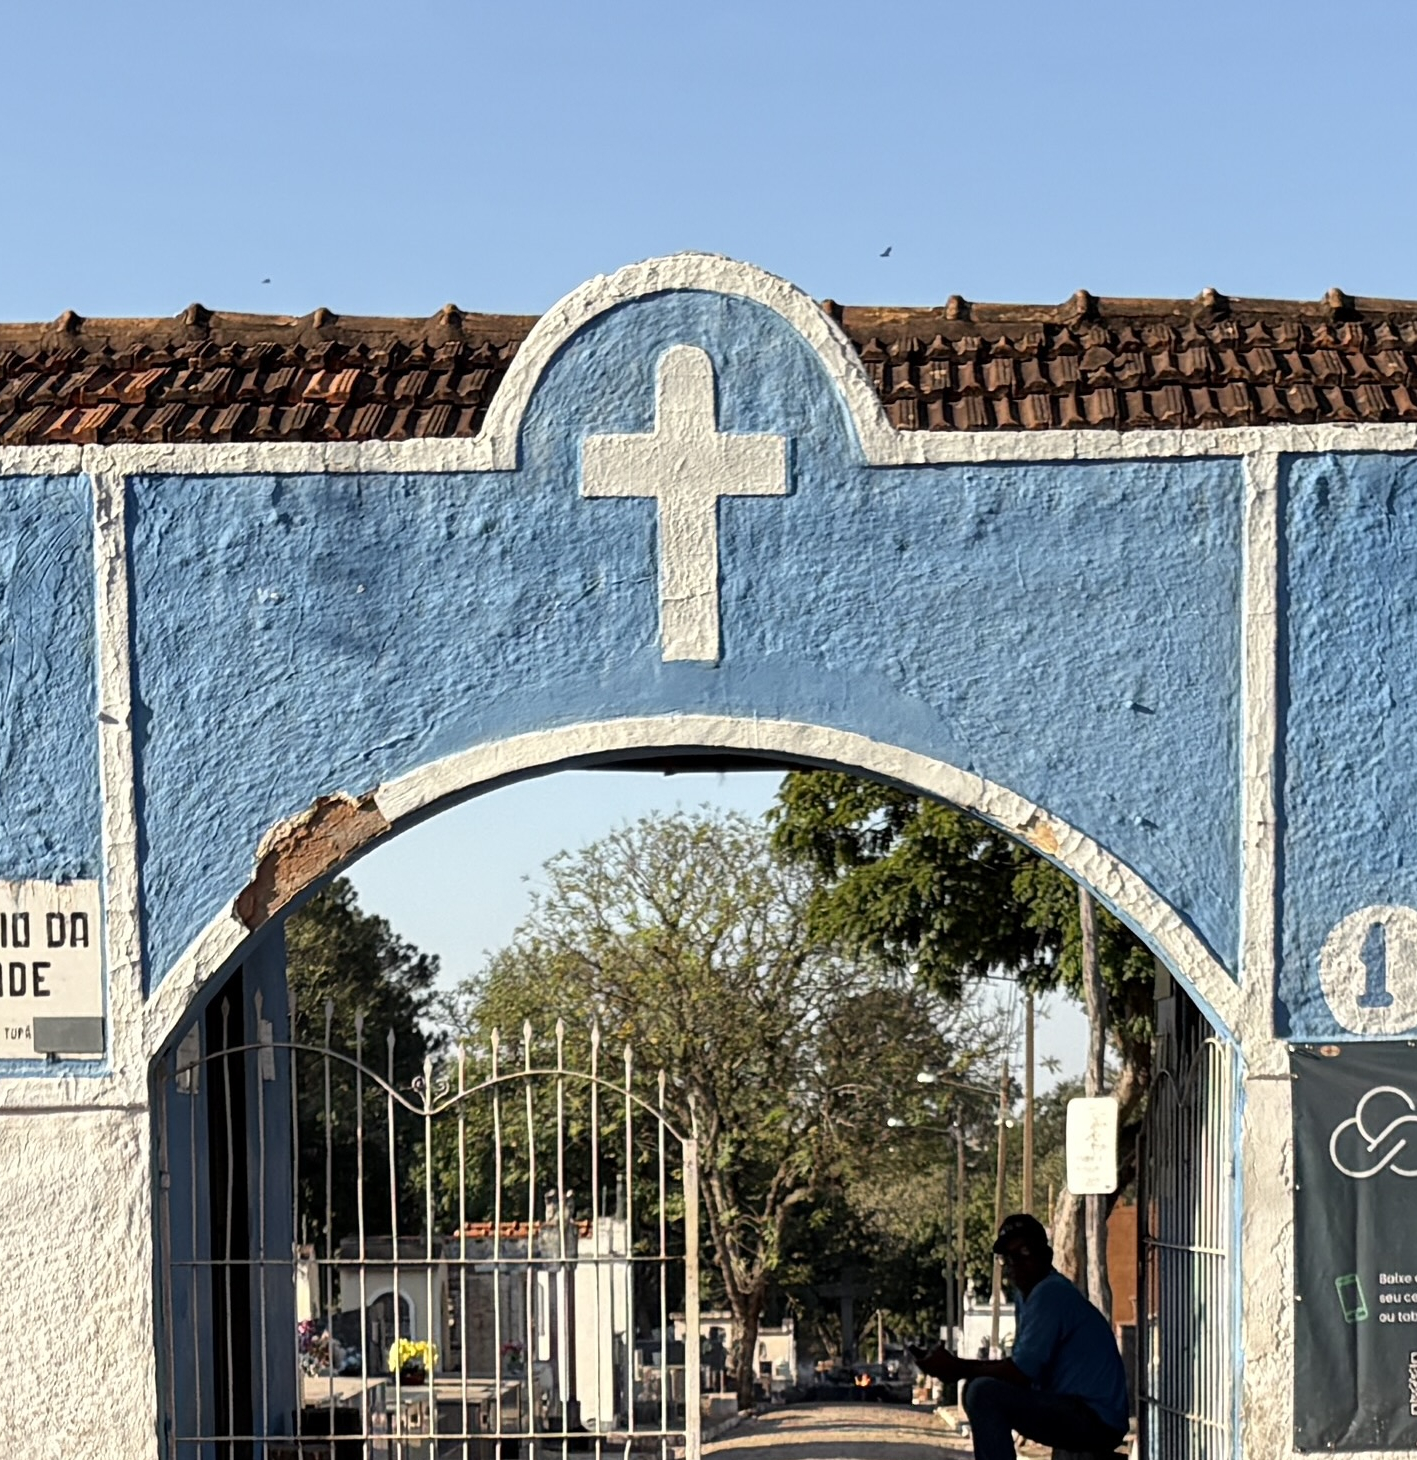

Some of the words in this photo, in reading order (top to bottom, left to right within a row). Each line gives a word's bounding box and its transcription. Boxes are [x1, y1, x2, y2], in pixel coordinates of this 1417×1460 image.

[46, 911, 89, 948] DA
[1356, 921, 1394, 1008] 1
[1379, 1272, 1412, 1284] Baixe
[1379, 1293, 1401, 1303] seu
[1379, 1313, 1395, 1323] ou
